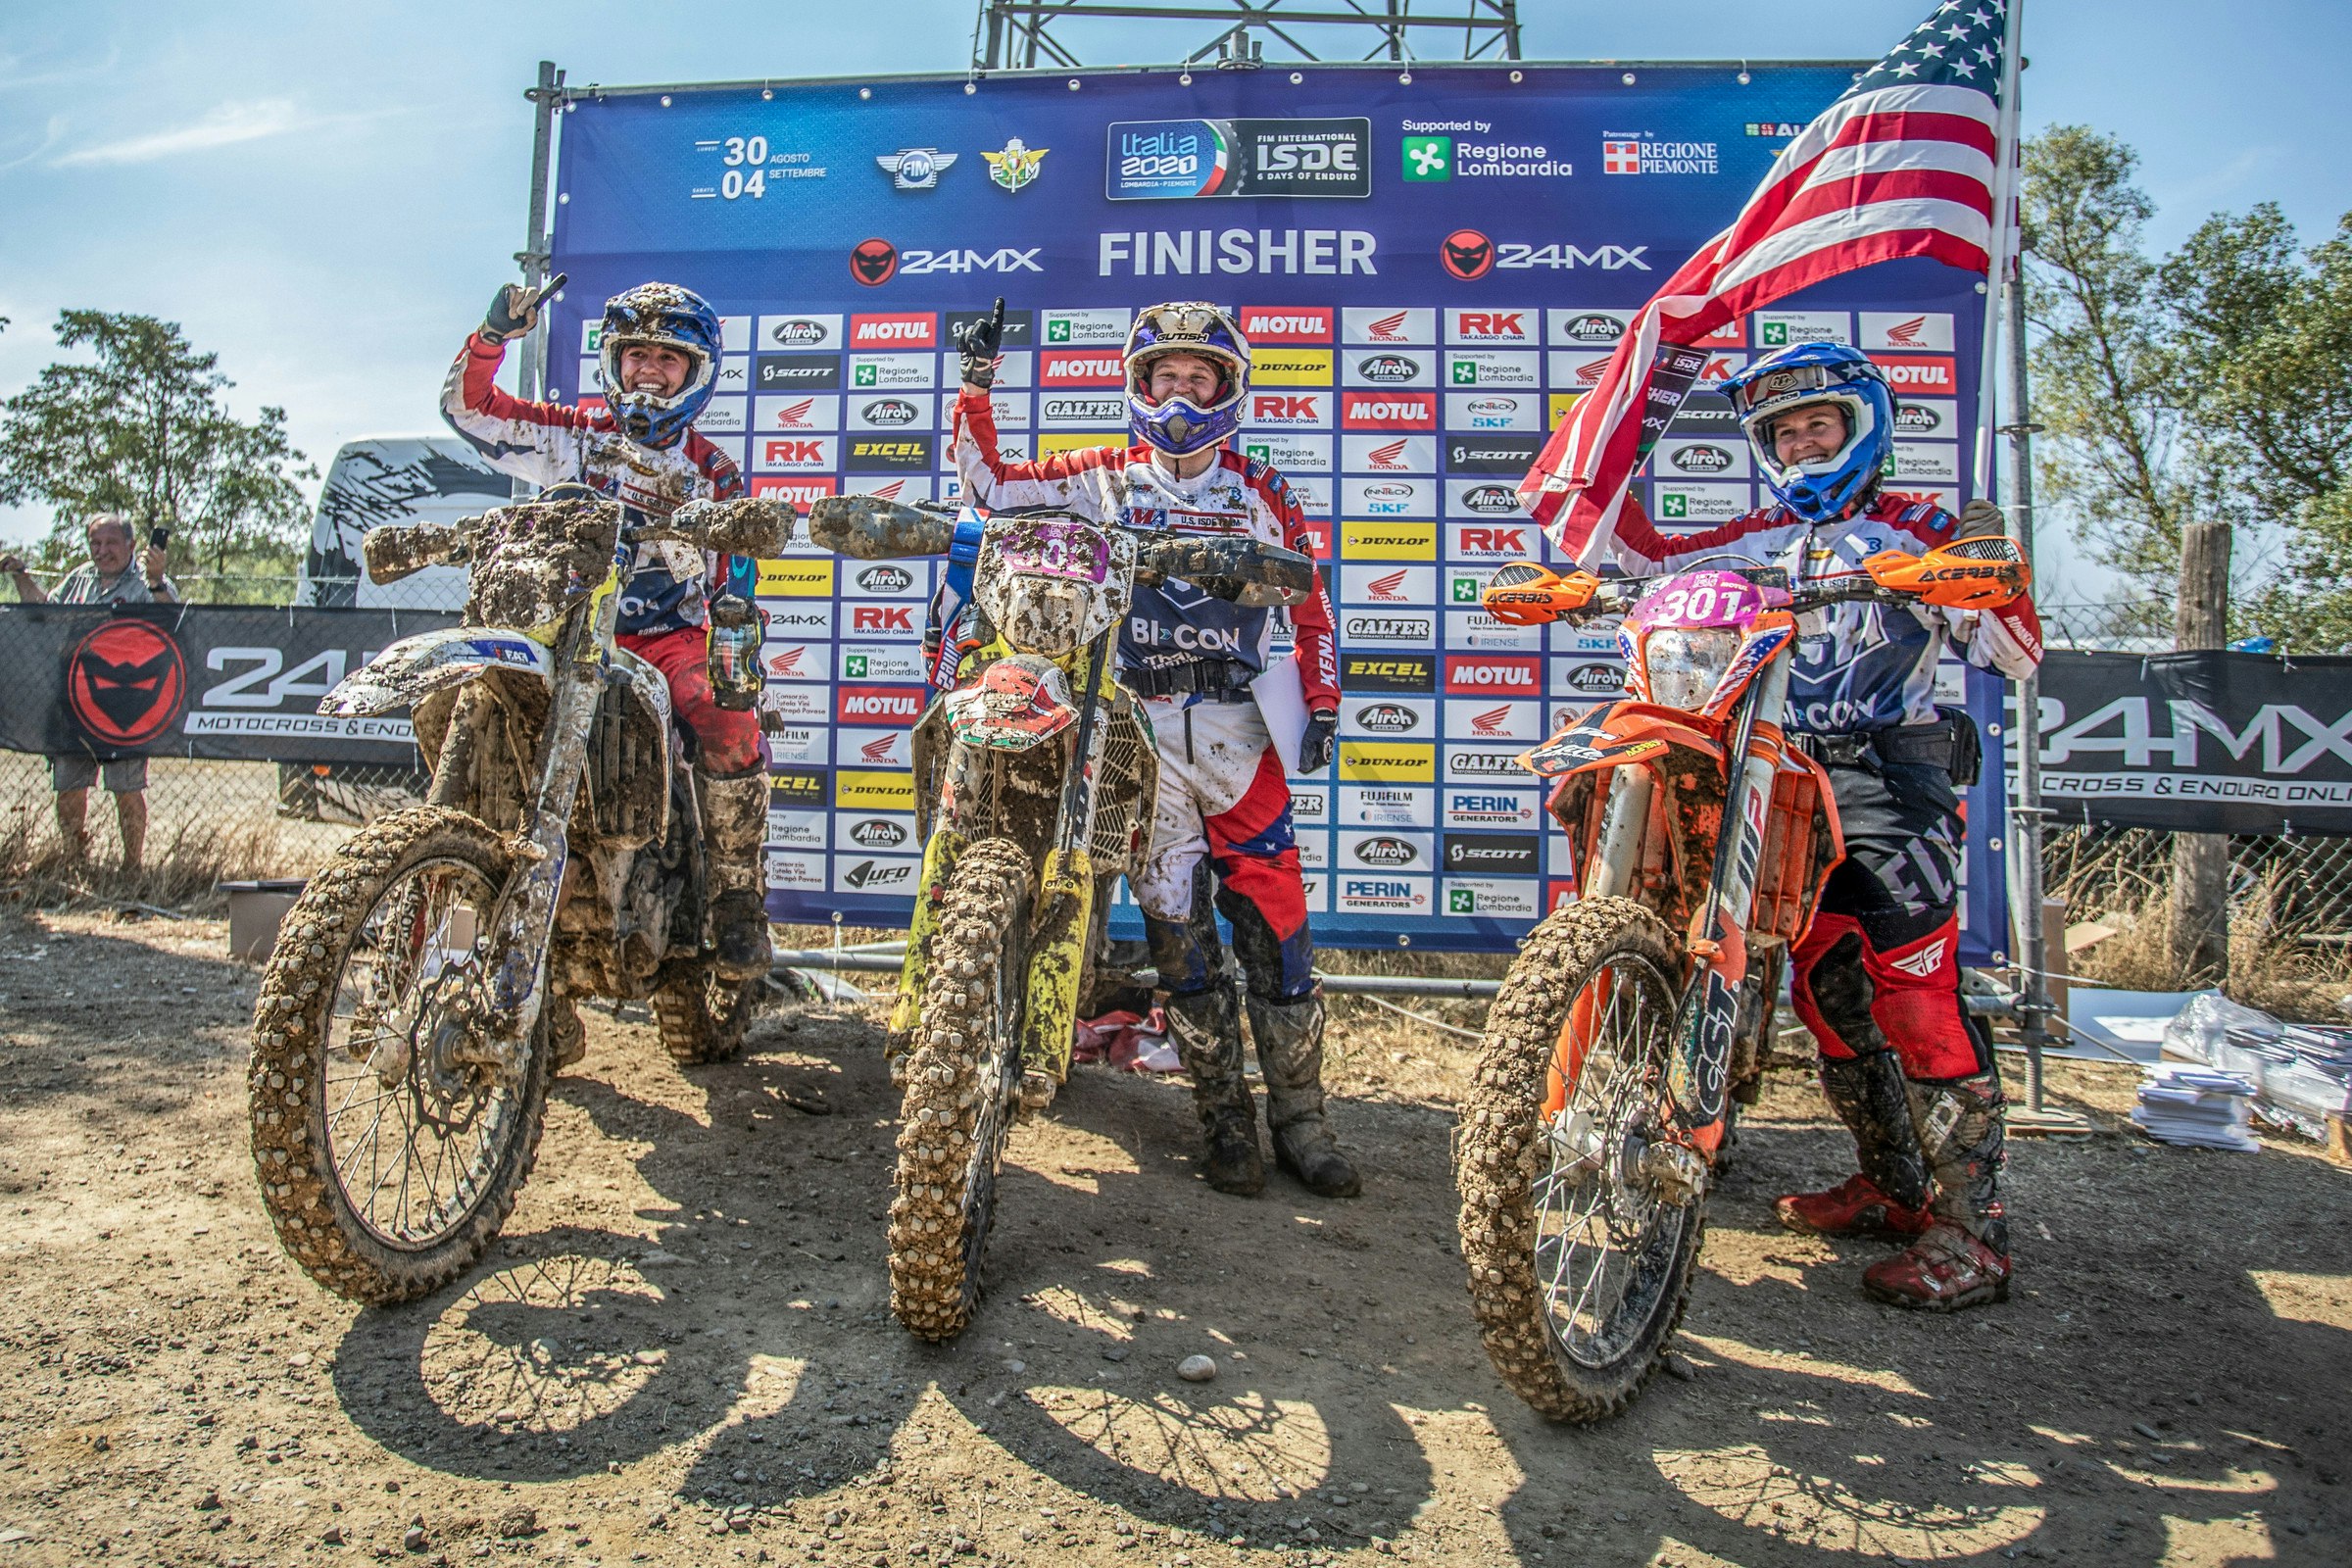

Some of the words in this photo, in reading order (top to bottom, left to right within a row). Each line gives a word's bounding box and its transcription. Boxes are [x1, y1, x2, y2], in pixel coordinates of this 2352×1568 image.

[1401, 120, 1472, 134] Supported
[1474, 120, 1492, 134] by
[1121, 131, 1198, 157] Italia
[1257, 134, 1275, 143] FIM
[1278, 132, 1357, 143] INTERNATIONAL
[723, 136, 768, 167] 30
[1256, 143, 1358, 172] ISDE
[1456, 143, 1547, 161] Regione
[1641, 141, 1718, 160] REGIONE
[769, 153, 810, 165] AGOSTO
[1121, 156, 1198, 176] 2021
[1641, 159, 1719, 174] PIEMONTE
[768, 168, 827, 179] SETTEMBRE
[903, 161, 930, 177] FIM
[1456, 160, 1573, 177] Lombardia
[721, 170, 766, 200] 04
[1099, 228, 1378, 276] FINISHER
[1494, 244, 1653, 270] 24MX
[899, 248, 1045, 274] 24MX
[777, 323, 822, 339] Airoh
[857, 321, 930, 340] MOTUL
[1072, 322, 1113, 331] Regione
[1248, 316, 1326, 334] MOTUL
[1459, 313, 1524, 335] RK
[1570, 318, 1620, 334] Airoh
[1789, 325, 1833, 335] Regione
[1072, 330, 1125, 339] Lombardia
[1155, 333, 1207, 342] GUTISH
[1789, 333, 1845, 342] Lombardia
[878, 368, 918, 376] Regione
[1047, 359, 1123, 376] MOTUL
[1363, 359, 1414, 376] Airoh
[1479, 365, 1522, 374] Regione
[1673, 357, 1702, 371] ISDE
[775, 368, 834, 377] SCOTT
[1479, 373, 1534, 382] Lombardia
[1646, 386, 1683, 407] SHER
[866, 403, 913, 418] Airoh
[1045, 400, 1123, 416] GALFER
[1254, 396, 1319, 418] RK
[1349, 402, 1429, 420] MOTUL
[1676, 410, 1736, 419] SCOTT
[1472, 417, 1513, 427] SKF
[765, 440, 824, 462] RK
[853, 443, 925, 457] EXCEL
[1272, 449, 1315, 458] Regione
[1466, 451, 1533, 461] SCOTT
[1676, 449, 1729, 466] Airoh
[1272, 457, 1327, 466] Lombardia
[1897, 458, 1940, 467] Regione
[1897, 466, 1953, 475] Lombardia
[759, 486, 827, 504] MOTUL
[1469, 489, 1520, 506] Airoh
[1689, 498, 1733, 508] Regione
[1368, 503, 1409, 514] SKF
[1689, 507, 1745, 515] Lombardia
[1181, 515, 1196, 525] U.S.
[1198, 516, 1217, 526] ISDE
[1361, 537, 1430, 546] DUNLOP
[1460, 528, 1526, 551] RK
[861, 569, 907, 586] Airoh
[1918, 565, 2015, 582] ACERB
[1720, 581, 1748, 592] MOTUL
[1487, 592, 1553, 604] ACERBIS
[1658, 586, 1743, 623] 301
[1319, 587, 1338, 630] MOTUL
[771, 614, 827, 626] 24MX
[853, 607, 913, 629] RK
[1347, 618, 1430, 636] GALFER
[1481, 638, 1519, 647] IRIENSE
[869, 660, 909, 668] Regione
[1318, 632, 1336, 690] KEN
[1348, 662, 1428, 676] EXCEL
[202, 647, 380, 708] 24
[1452, 665, 1534, 685] MOTUL
[1573, 667, 1623, 685] Airoh
[844, 697, 918, 715] MOTUL
[1362, 708, 1412, 725] Airoh
[197, 716, 339, 735] MOTOCROSS
[345, 720, 359, 736] &
[362, 721, 415, 738] END
[769, 731, 809, 741] UJIFILM
[1625, 739, 1662, 758] ACERBIS
[1358, 759, 1428, 767] DUNLOP
[1450, 754, 1525, 771] GALFE
[1360, 791, 1413, 802] FUJIFILM
[2007, 774, 2144, 793] TCROSS
[2154, 776, 2172, 795] &
[2179, 781, 2278, 800] ENDURO
[2286, 786, 2352, 803] ONLI
[1452, 795, 1518, 812] PERIN
[1374, 812, 1413, 822] IRIENSE
[771, 824, 810, 834] Regione
[855, 823, 903, 840] Airoh
[771, 833, 821, 843] Lombardia
[1360, 841, 1411, 858] Airoh
[1465, 848, 1532, 859] SCOTT
[868, 866, 911, 882] UFO
[1347, 880, 1411, 898] PERIN
[1346, 900, 1411, 908] GENERATORS
[1477, 894, 1520, 904] Regione
[1476, 903, 1533, 912] Lombardia
